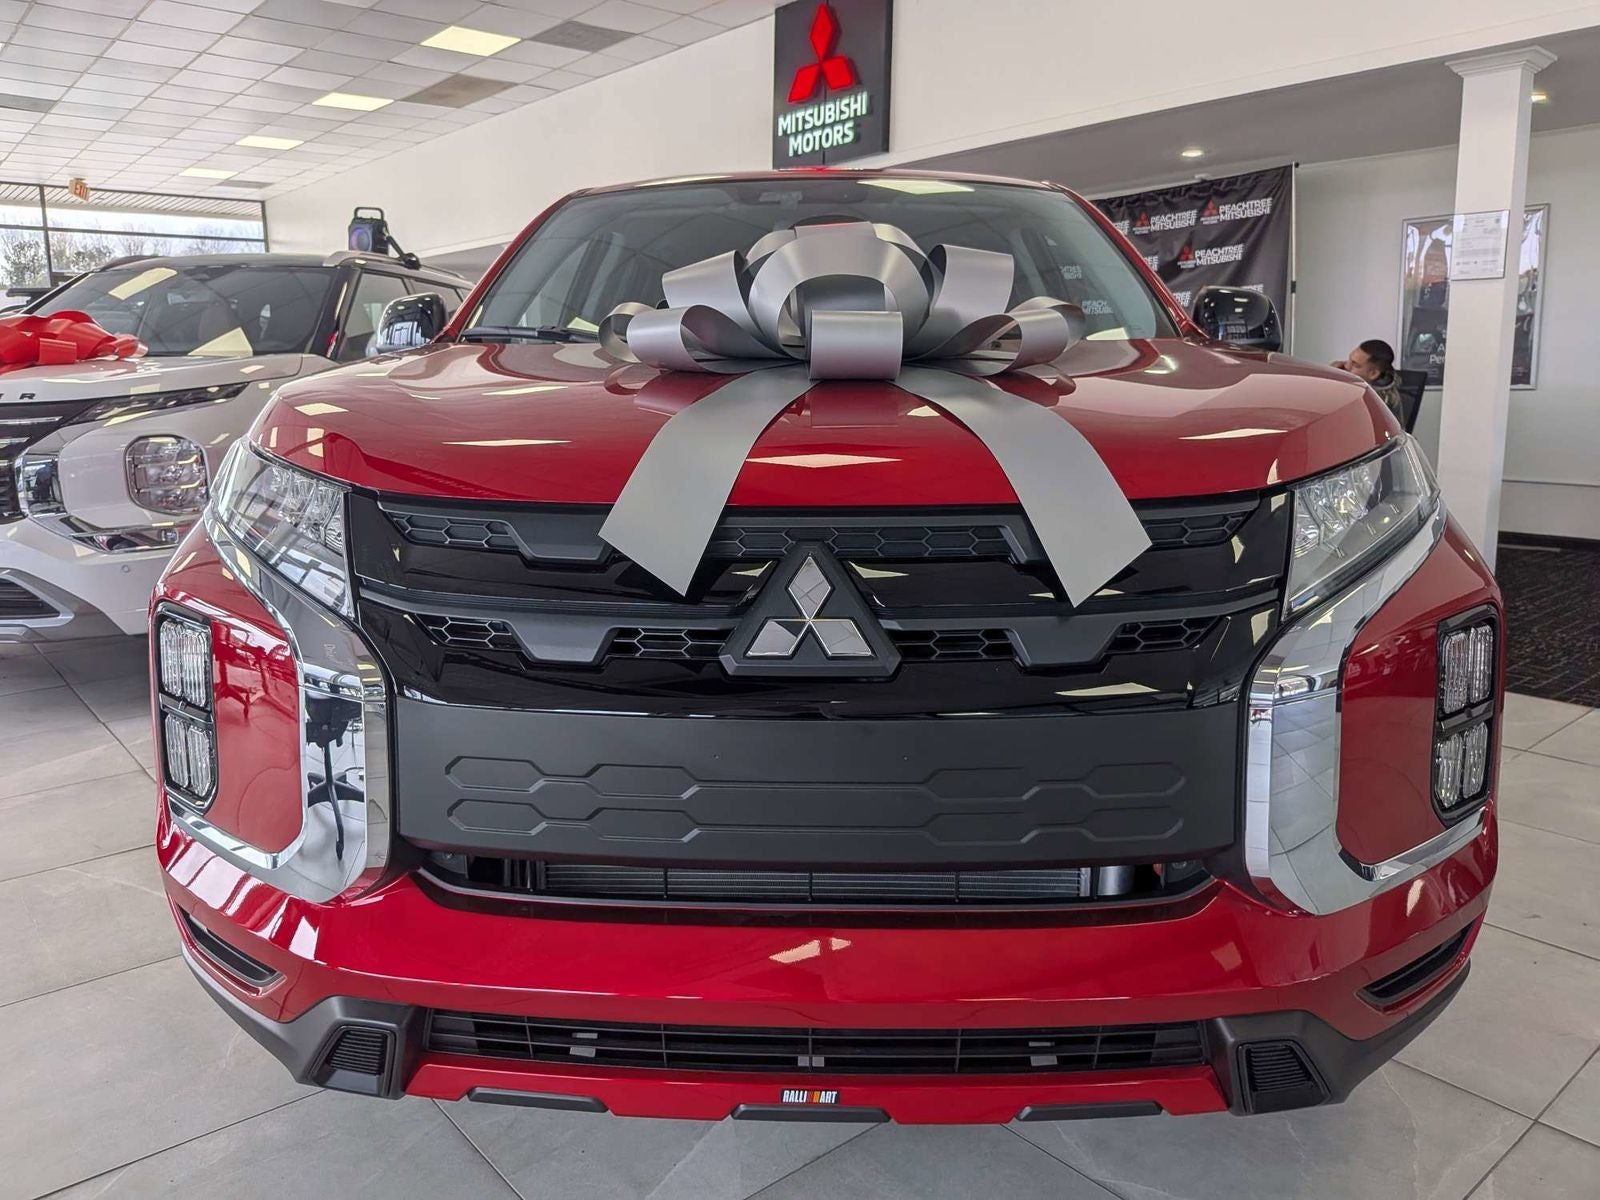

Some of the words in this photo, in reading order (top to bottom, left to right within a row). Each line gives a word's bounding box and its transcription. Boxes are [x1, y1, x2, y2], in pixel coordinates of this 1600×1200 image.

[777, 91, 868, 137] MITSUBISHI
[788, 120, 854, 157] MOTORS
[1219, 197, 1272, 213] PEACHTREE
[1150, 209, 1197, 223] PEACHTREE
[1219, 206, 1270, 221] MITSUBISHI
[1150, 216, 1195, 231] MITSUBISHI
[1195, 244, 1243, 257] PEACHTREE
[1196, 251, 1242, 266] MITSUBISHI
[782, 1090, 837, 1103] RALLIART
